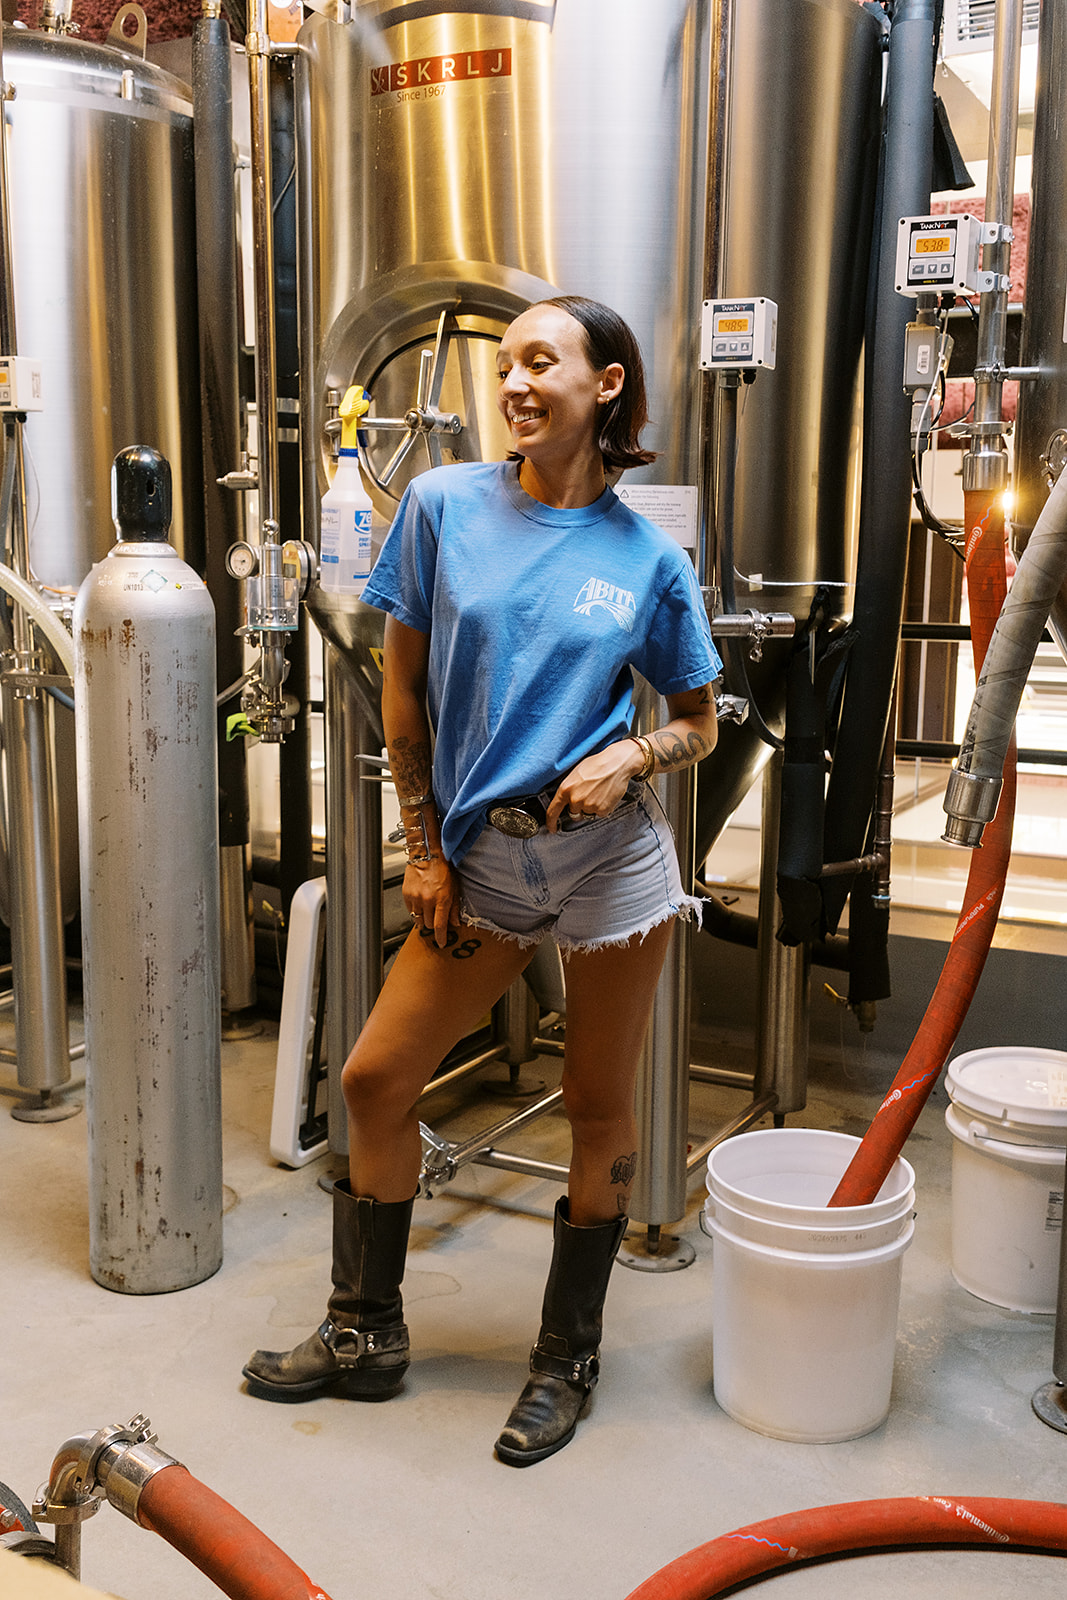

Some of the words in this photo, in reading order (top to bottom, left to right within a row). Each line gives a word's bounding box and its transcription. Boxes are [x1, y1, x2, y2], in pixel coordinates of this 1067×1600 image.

[397, 90, 421, 102] Since
[423, 85, 446, 99] 1967
[573, 576, 637, 612] ABITA
